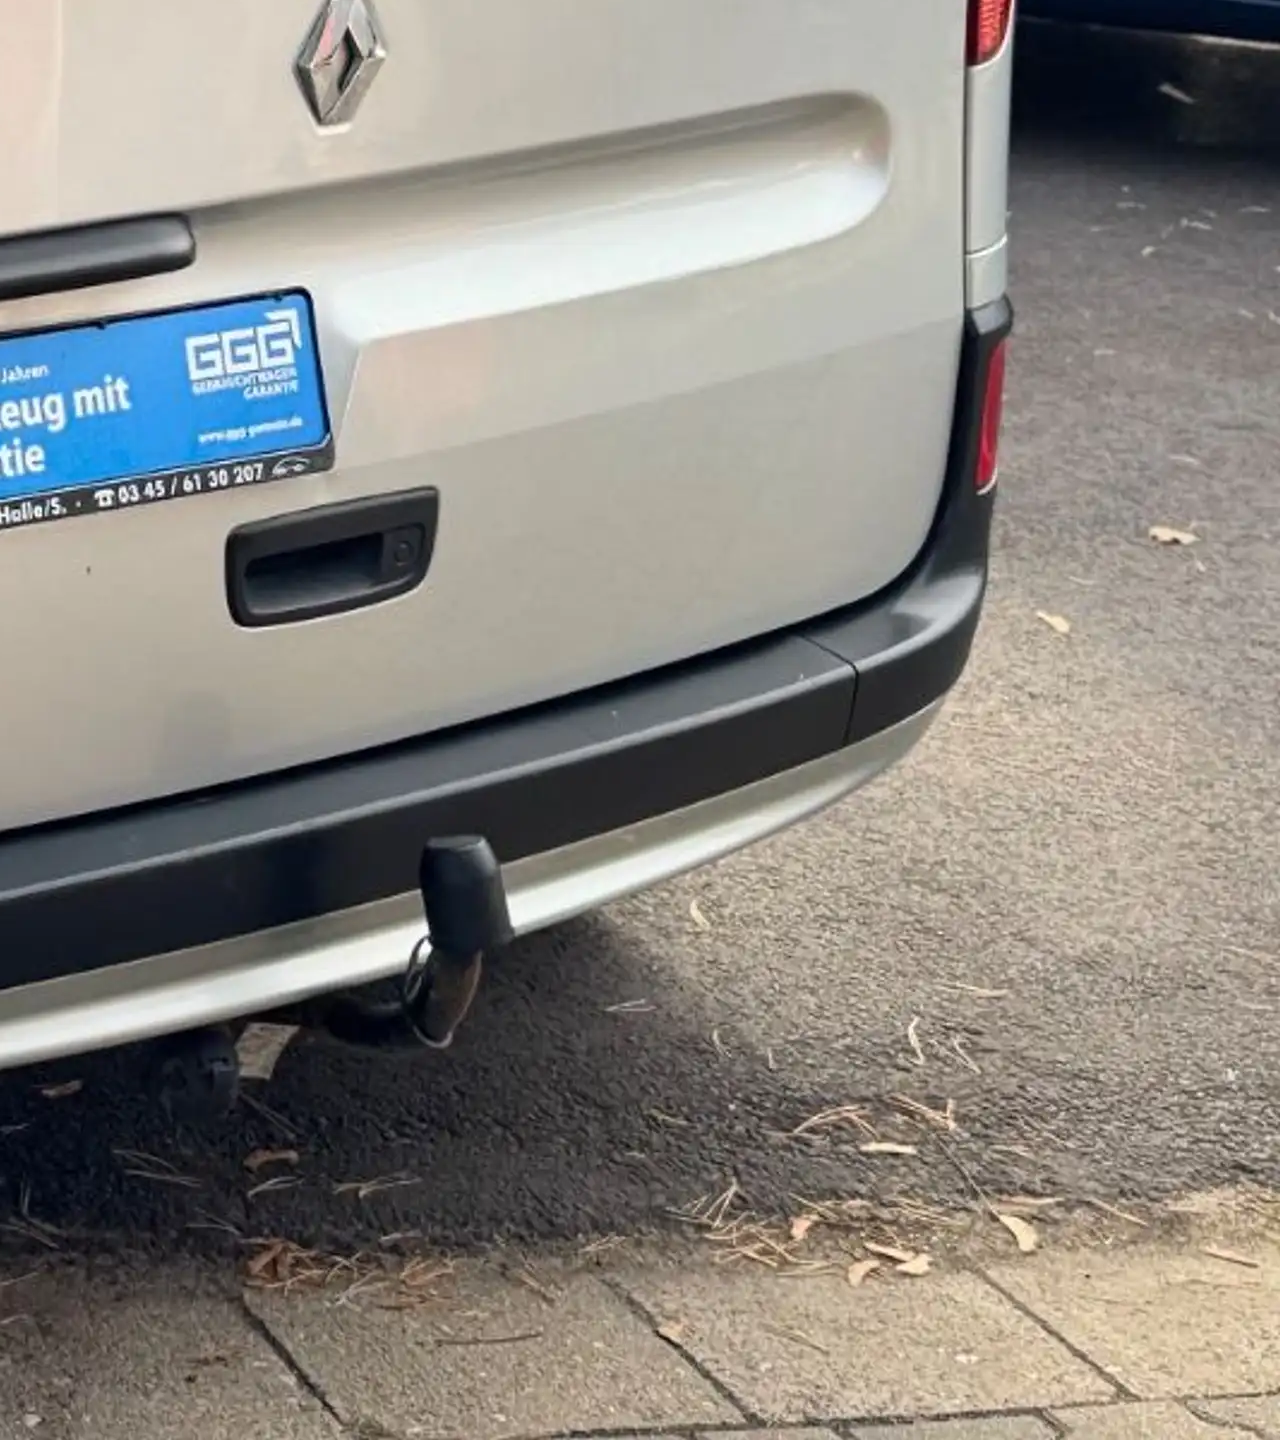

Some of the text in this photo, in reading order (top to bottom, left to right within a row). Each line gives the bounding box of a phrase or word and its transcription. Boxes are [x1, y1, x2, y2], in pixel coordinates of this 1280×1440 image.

[185, 318, 296, 381] GGG
[2, 363, 50, 385] Jahren
[73, 373, 132, 419] mit
[118, 485, 139, 504] 03
[143, 479, 166, 498] 45
[183, 472, 203, 492] 61
[233, 462, 265, 484] 207
